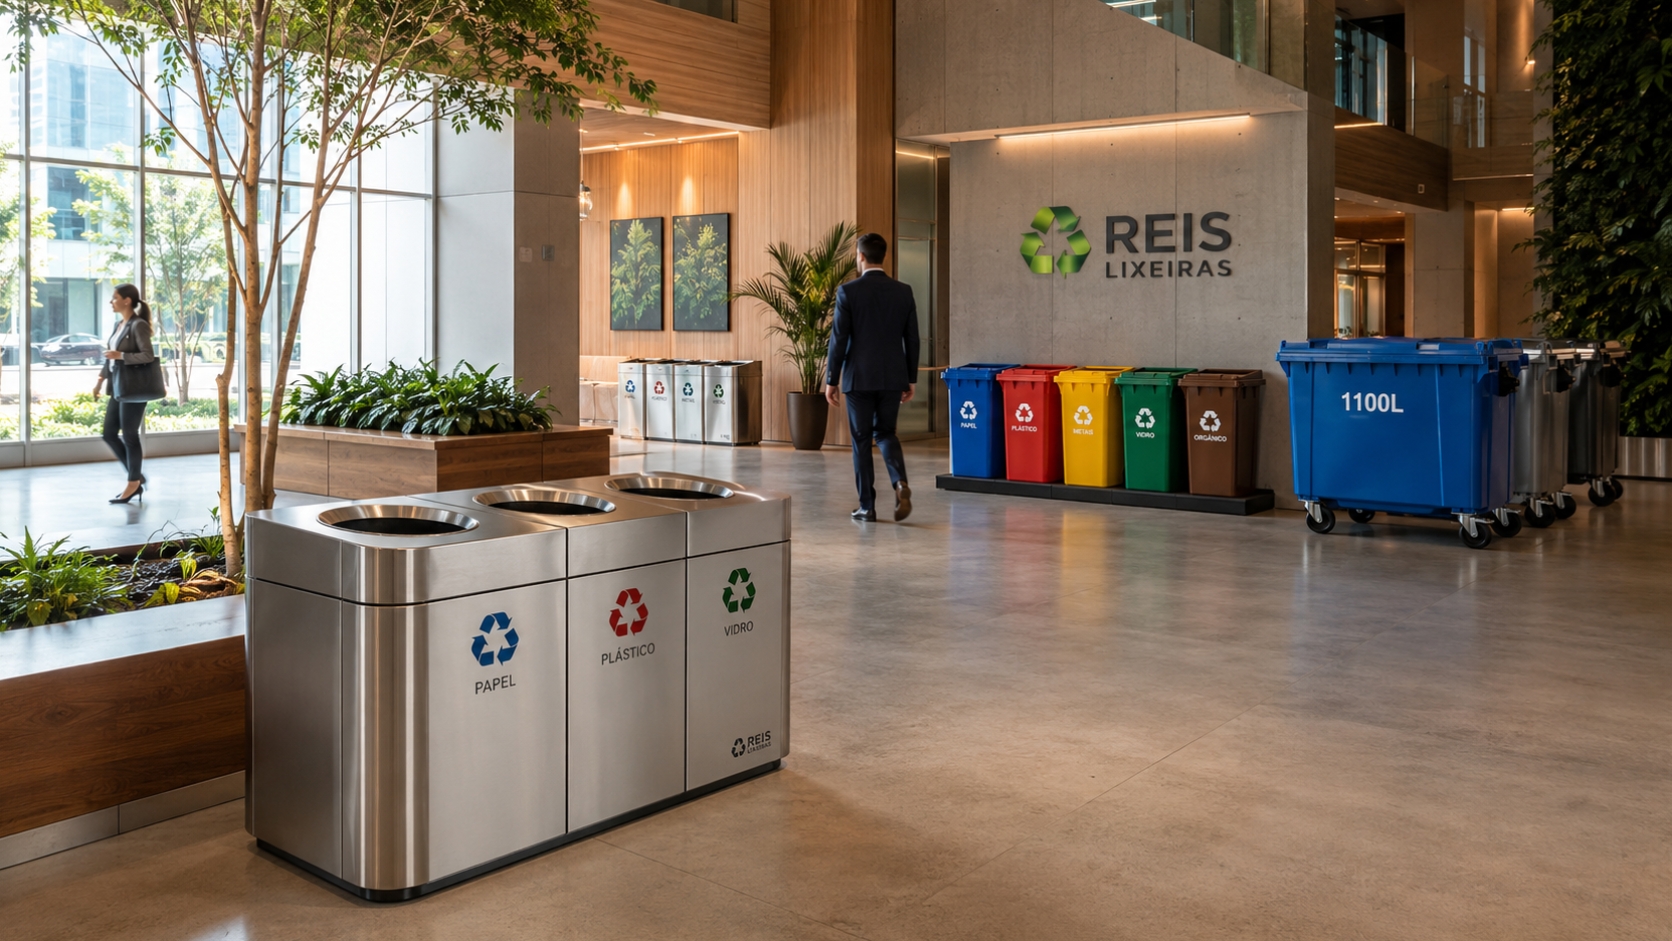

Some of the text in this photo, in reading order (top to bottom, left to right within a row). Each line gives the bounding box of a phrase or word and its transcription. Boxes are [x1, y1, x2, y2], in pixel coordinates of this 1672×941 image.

[1106, 211, 1232, 254] REIS
[1106, 260, 1232, 278] LIXEIRAS
[1341, 391, 1404, 413] 1100L
[724, 621, 754, 636] VIDRO
[601, 642, 656, 666] PLÁSTICO
[475, 674, 516, 695] PAPEL
[747, 730, 772, 748] REIS
